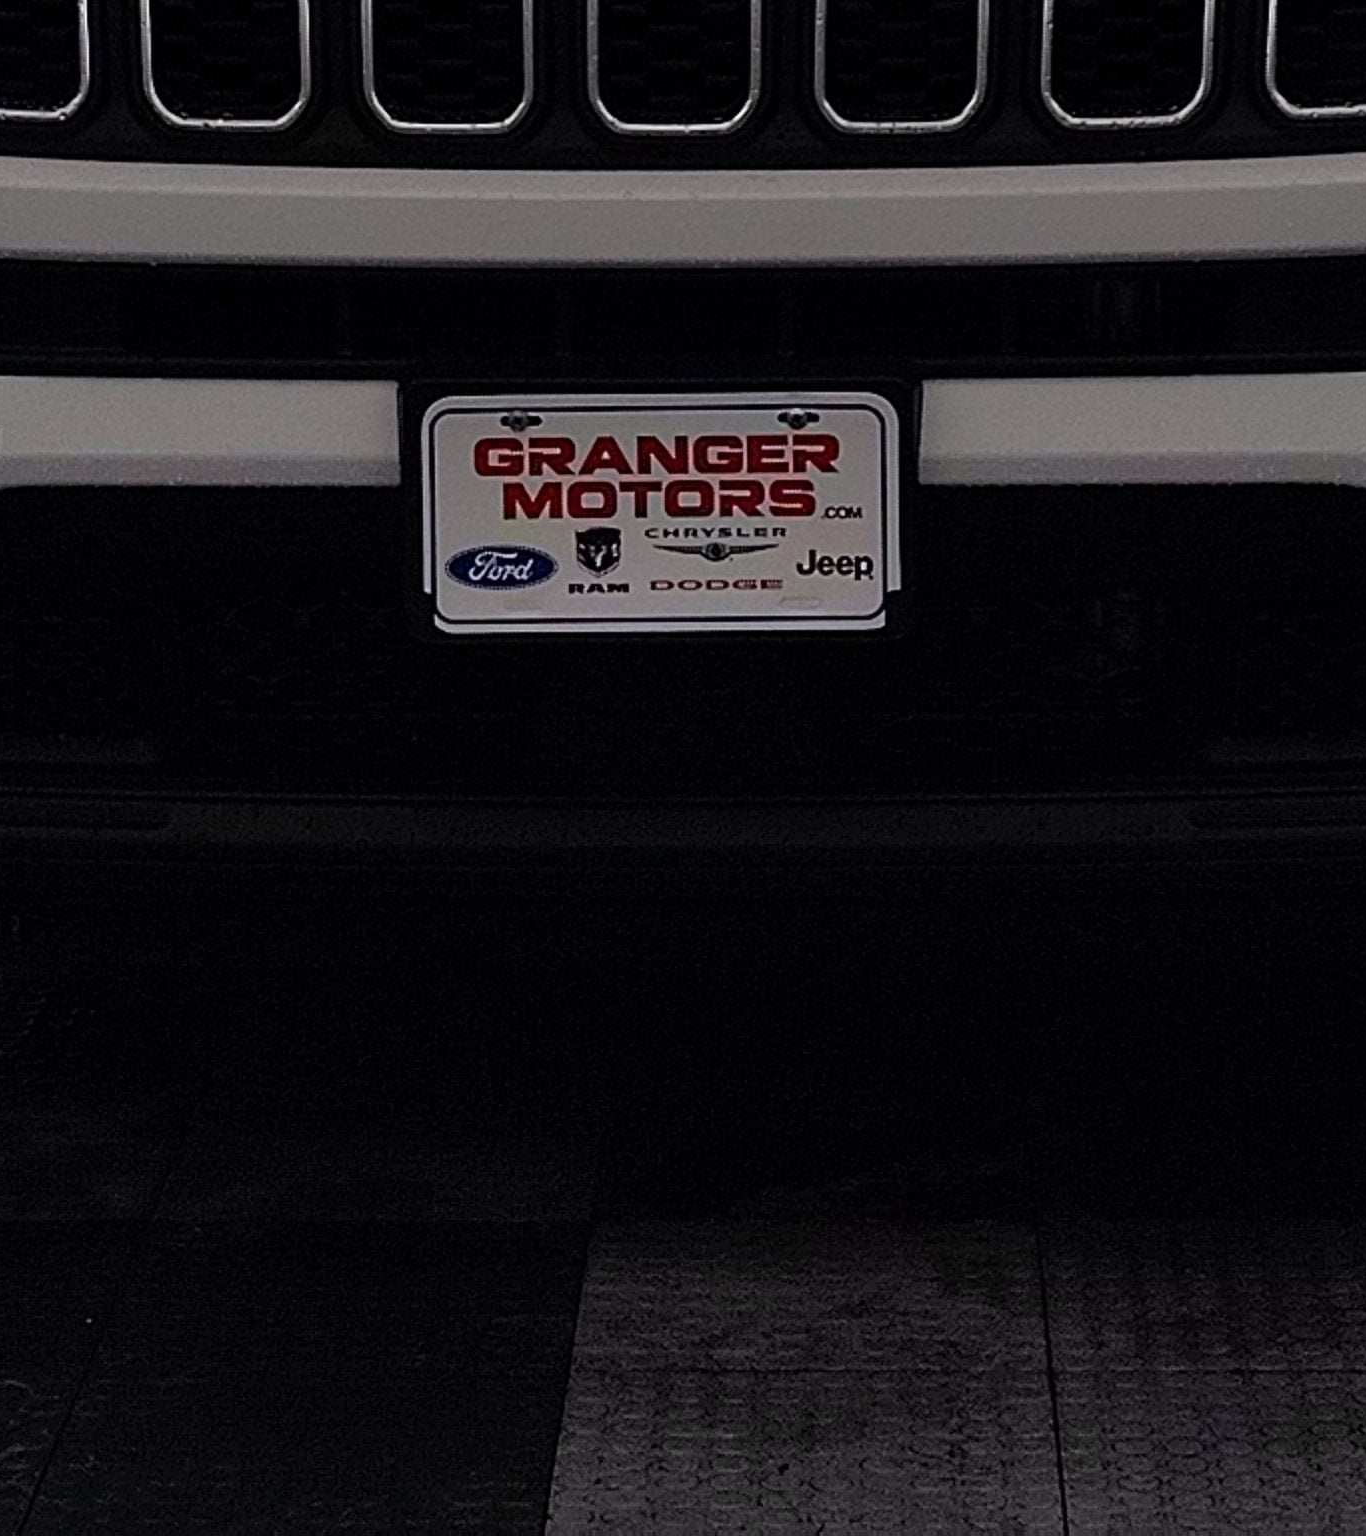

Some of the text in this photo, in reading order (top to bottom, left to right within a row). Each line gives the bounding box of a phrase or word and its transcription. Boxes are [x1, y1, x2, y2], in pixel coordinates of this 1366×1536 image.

[473, 433, 840, 477] GRANGER
[502, 479, 816, 520] MOTORS
[644, 527, 788, 539] CHRYSLER
[468, 550, 535, 581] Ford
[796, 549, 874, 581] Jeep
[568, 583, 630, 594] RAM
[650, 579, 784, 591] DODGE
